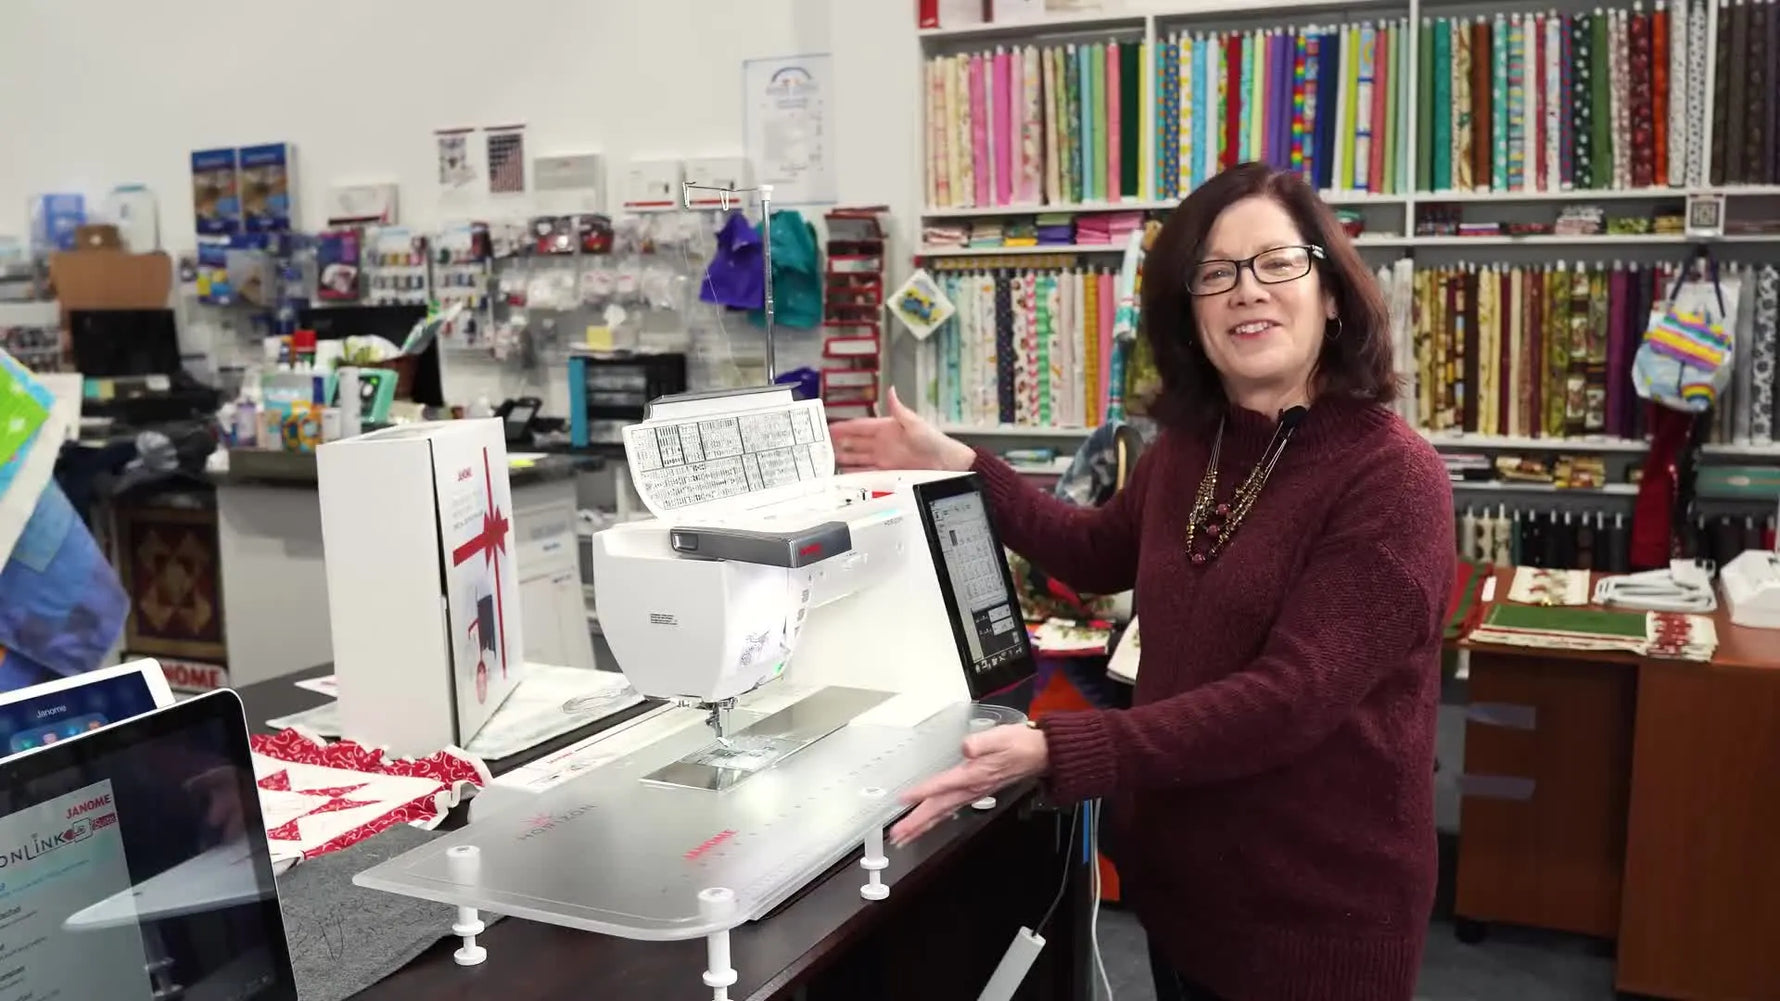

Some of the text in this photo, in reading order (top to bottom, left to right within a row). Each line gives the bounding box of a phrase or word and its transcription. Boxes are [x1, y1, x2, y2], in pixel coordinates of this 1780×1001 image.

[163, 664, 219, 688] NOME
[36, 705, 67, 719] Janome
[66, 794, 112, 820] JANOME
